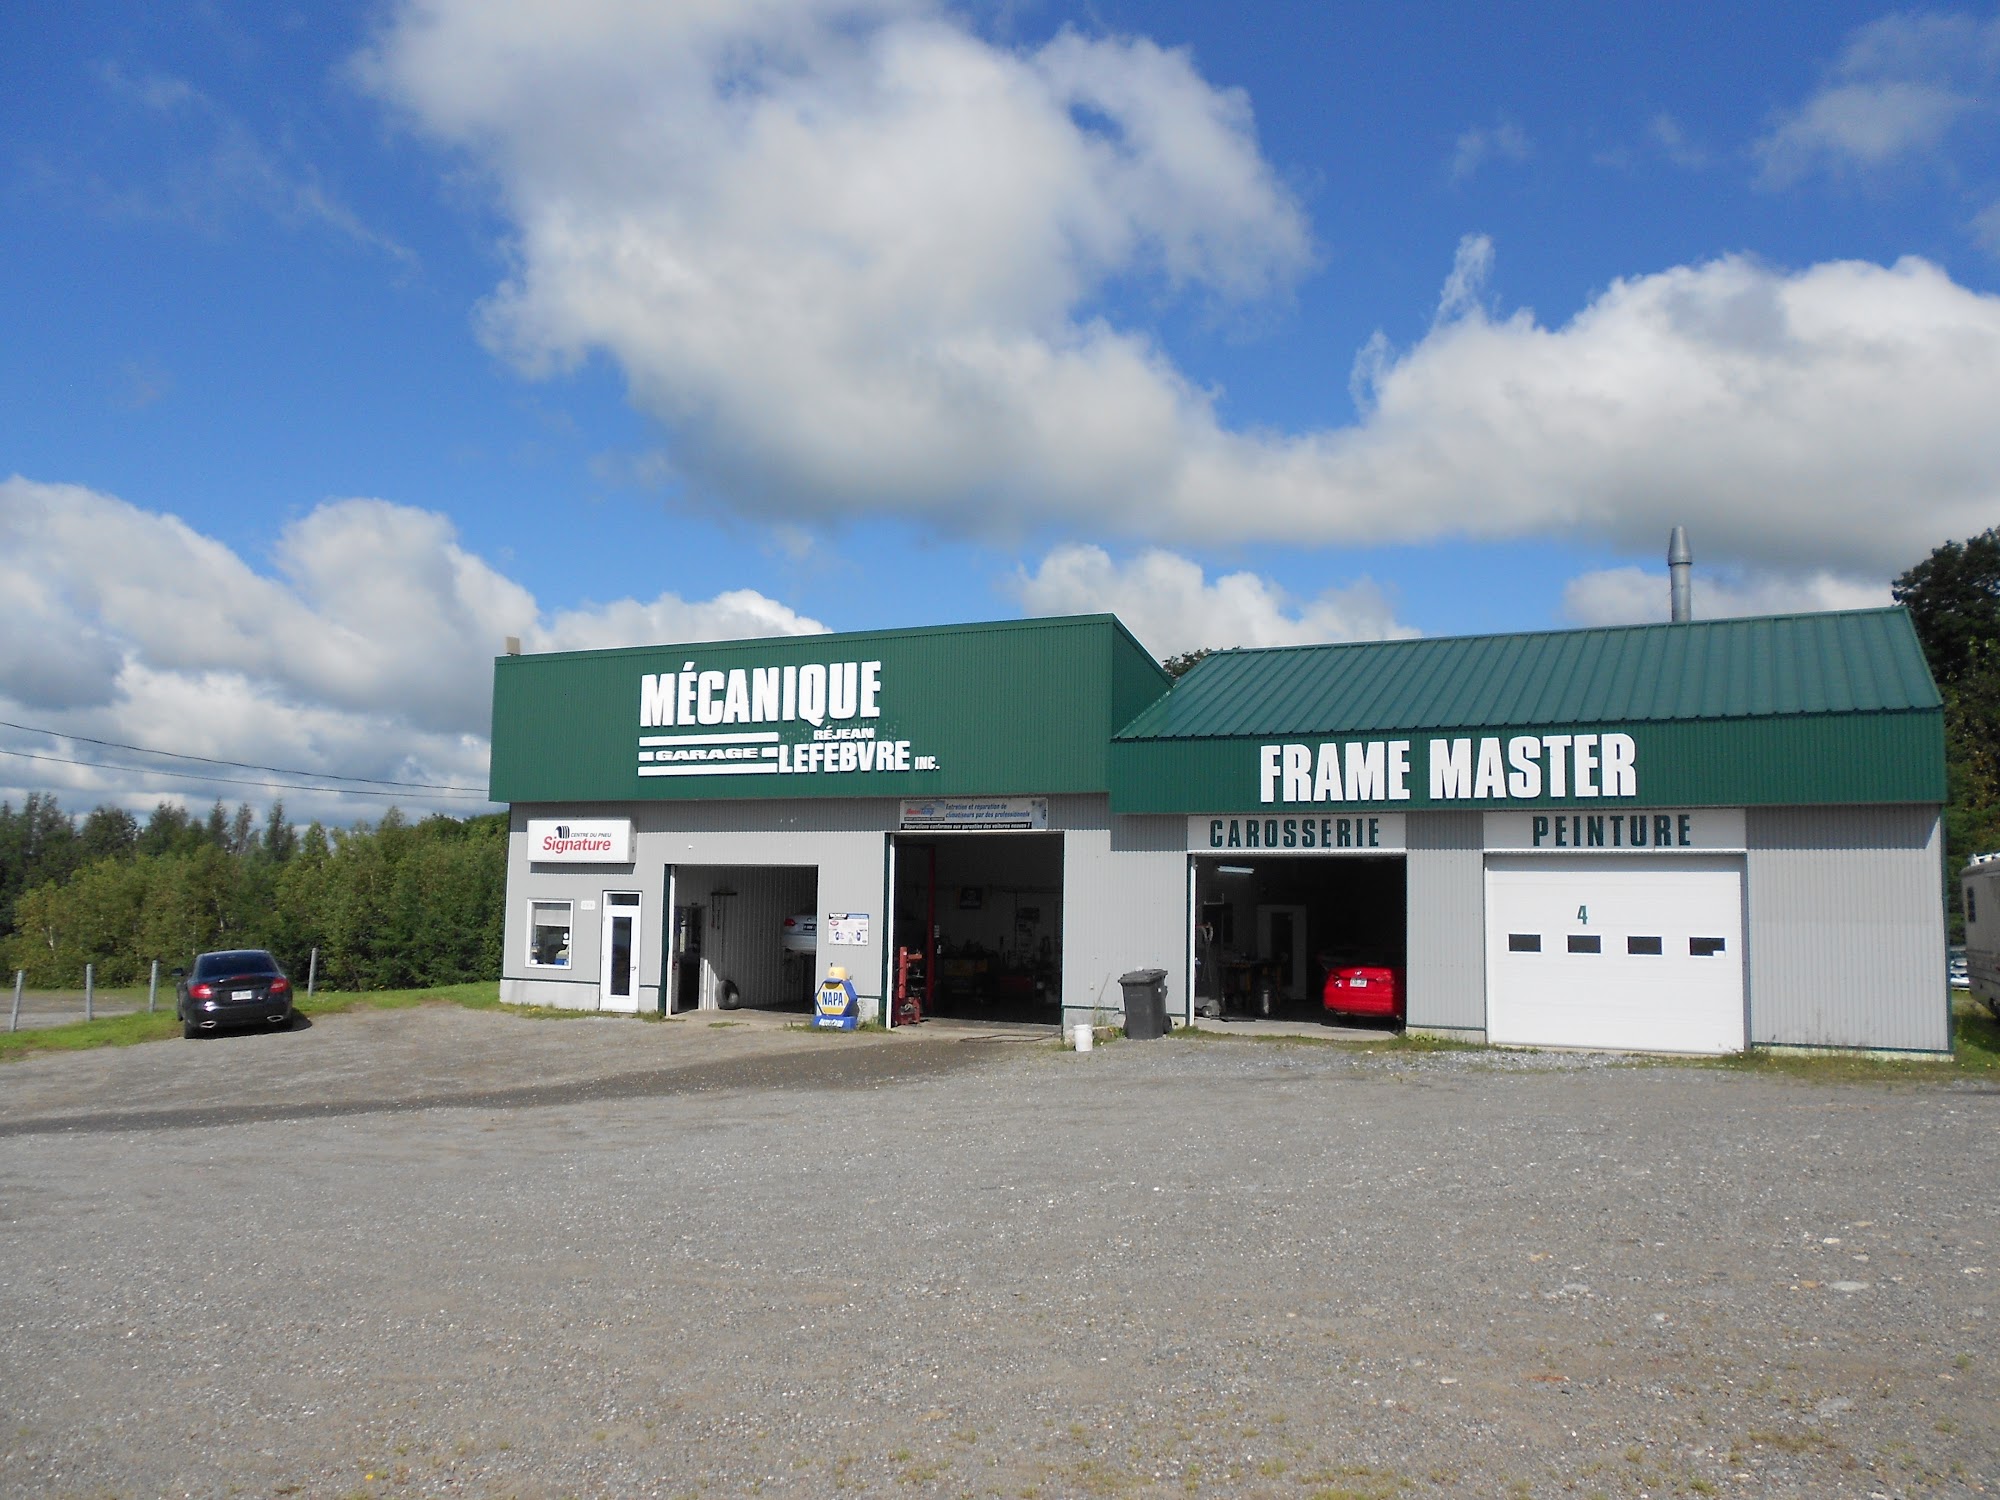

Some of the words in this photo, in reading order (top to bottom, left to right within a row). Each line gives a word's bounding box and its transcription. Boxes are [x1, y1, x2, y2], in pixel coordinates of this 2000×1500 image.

[640, 661, 881, 727] MÉCANIQUE
[813, 726, 874, 740] RÉJEAN
[655, 748, 758, 761] GARAGE
[779, 741, 910, 773] LEFEBVRE
[915, 756, 940, 770] INC.
[1260, 741, 1410, 802] FRAME
[1429, 733, 1637, 799] MASTER
[994, 810, 1030, 819] professionnels
[1210, 818, 1379, 848] CAROSSERIE
[1532, 814, 1691, 847] PEINTURE
[543, 836, 611, 854] Signature
[1577, 905, 1588, 925] 4
[822, 991, 843, 1006] NAPA
